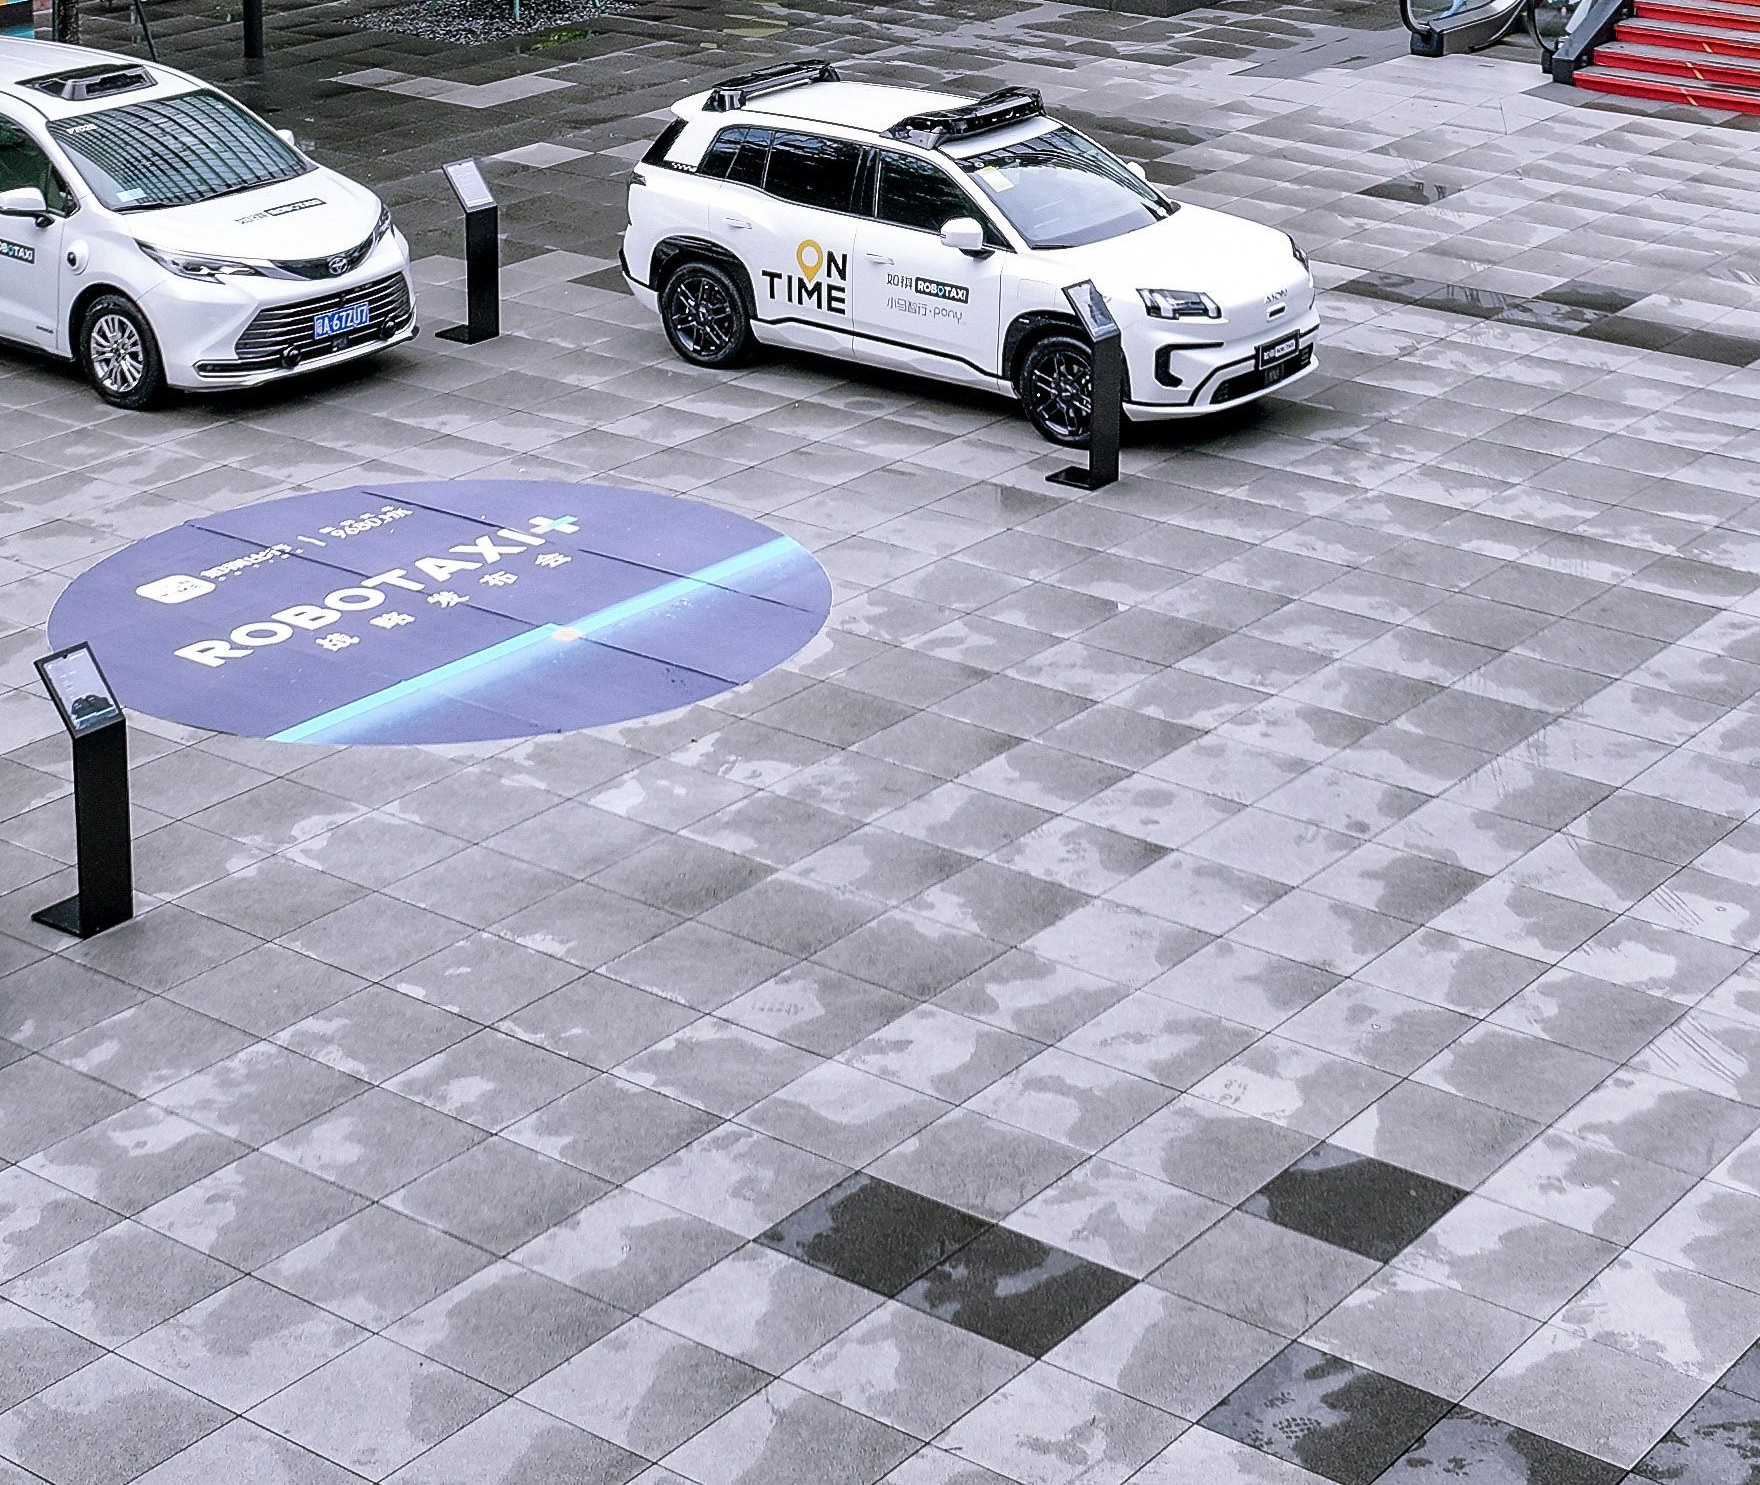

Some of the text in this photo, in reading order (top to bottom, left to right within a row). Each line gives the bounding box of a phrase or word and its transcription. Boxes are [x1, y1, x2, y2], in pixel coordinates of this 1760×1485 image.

[796, 239, 848, 282] ON
[761, 269, 846, 316] TIME
[917, 280, 968, 302] ROBOTAXI
[315, 552, 572, 652] 战略发布会
